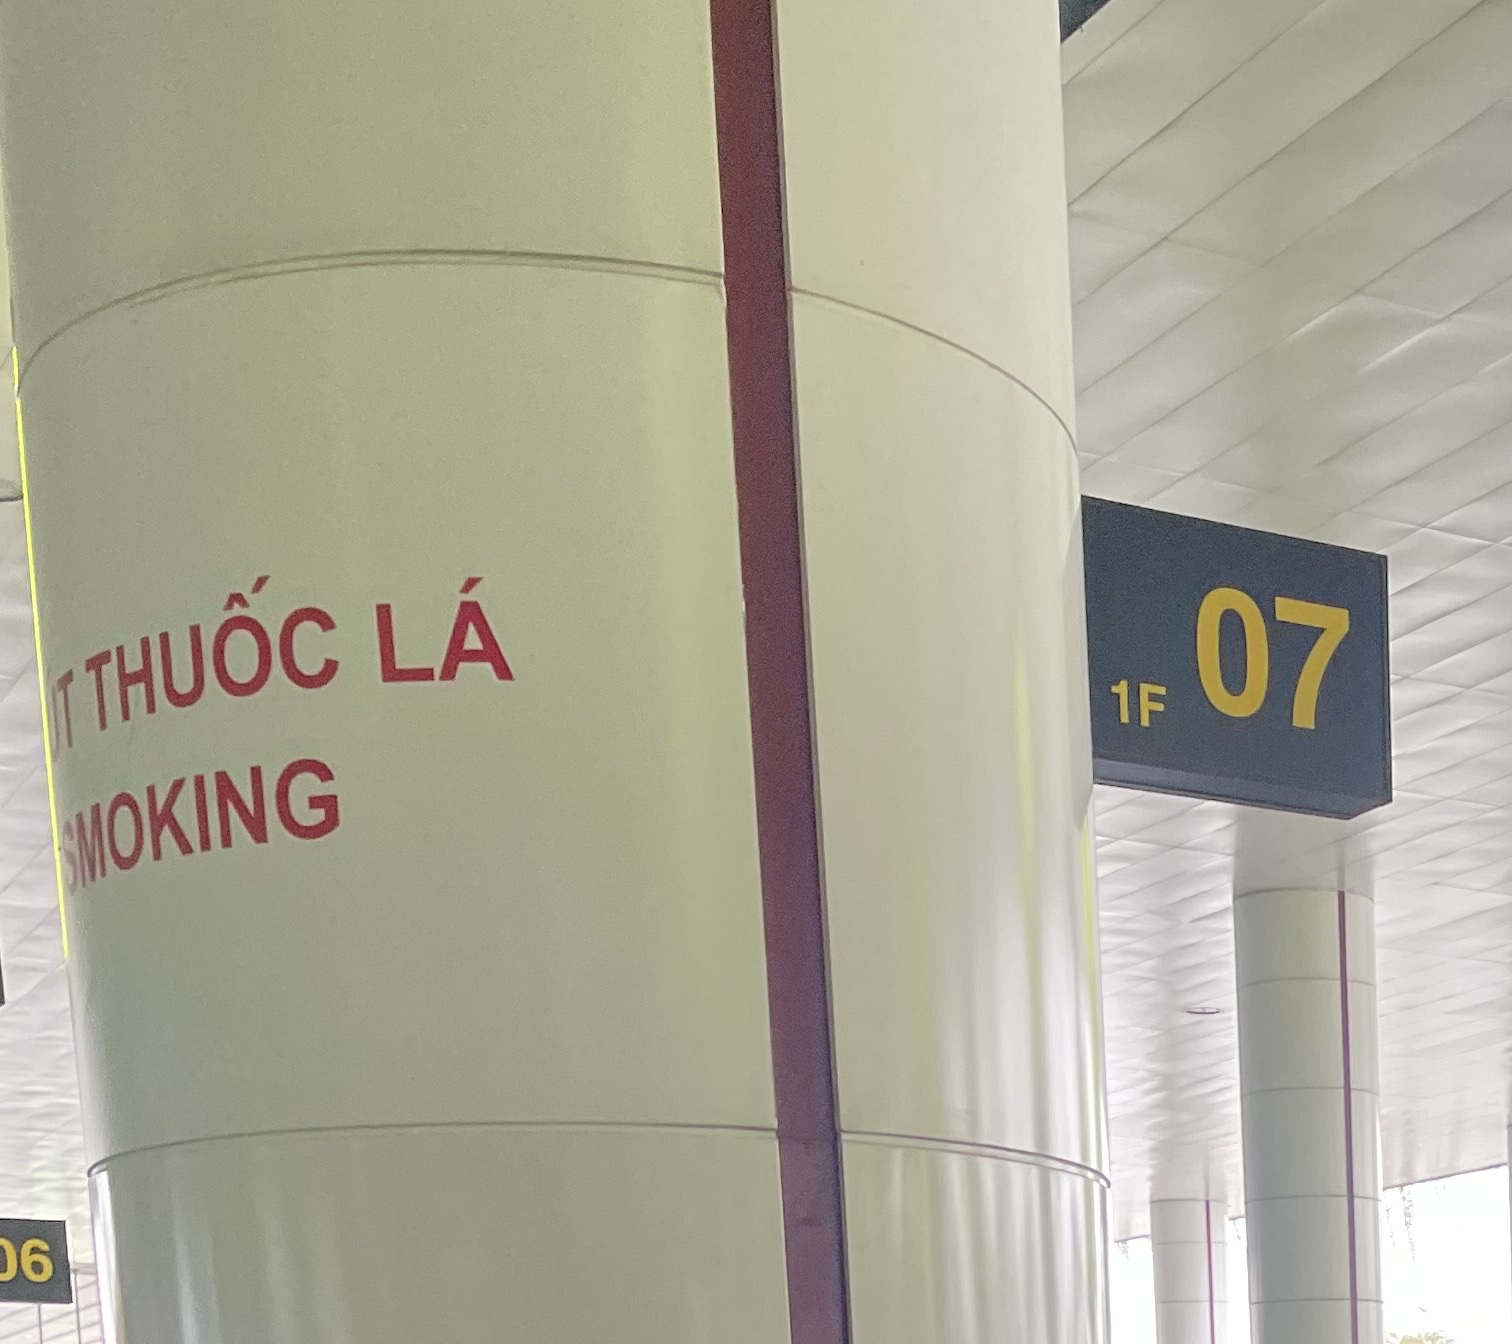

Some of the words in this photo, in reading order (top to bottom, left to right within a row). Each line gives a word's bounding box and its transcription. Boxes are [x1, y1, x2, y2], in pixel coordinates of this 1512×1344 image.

[84, 575, 340, 732] THUỐC
[375, 576, 516, 684] LÁ
[1110, 679, 1167, 728] 1F
[1196, 586, 1350, 730] 07
[62, 758, 341, 896] SMOKING
